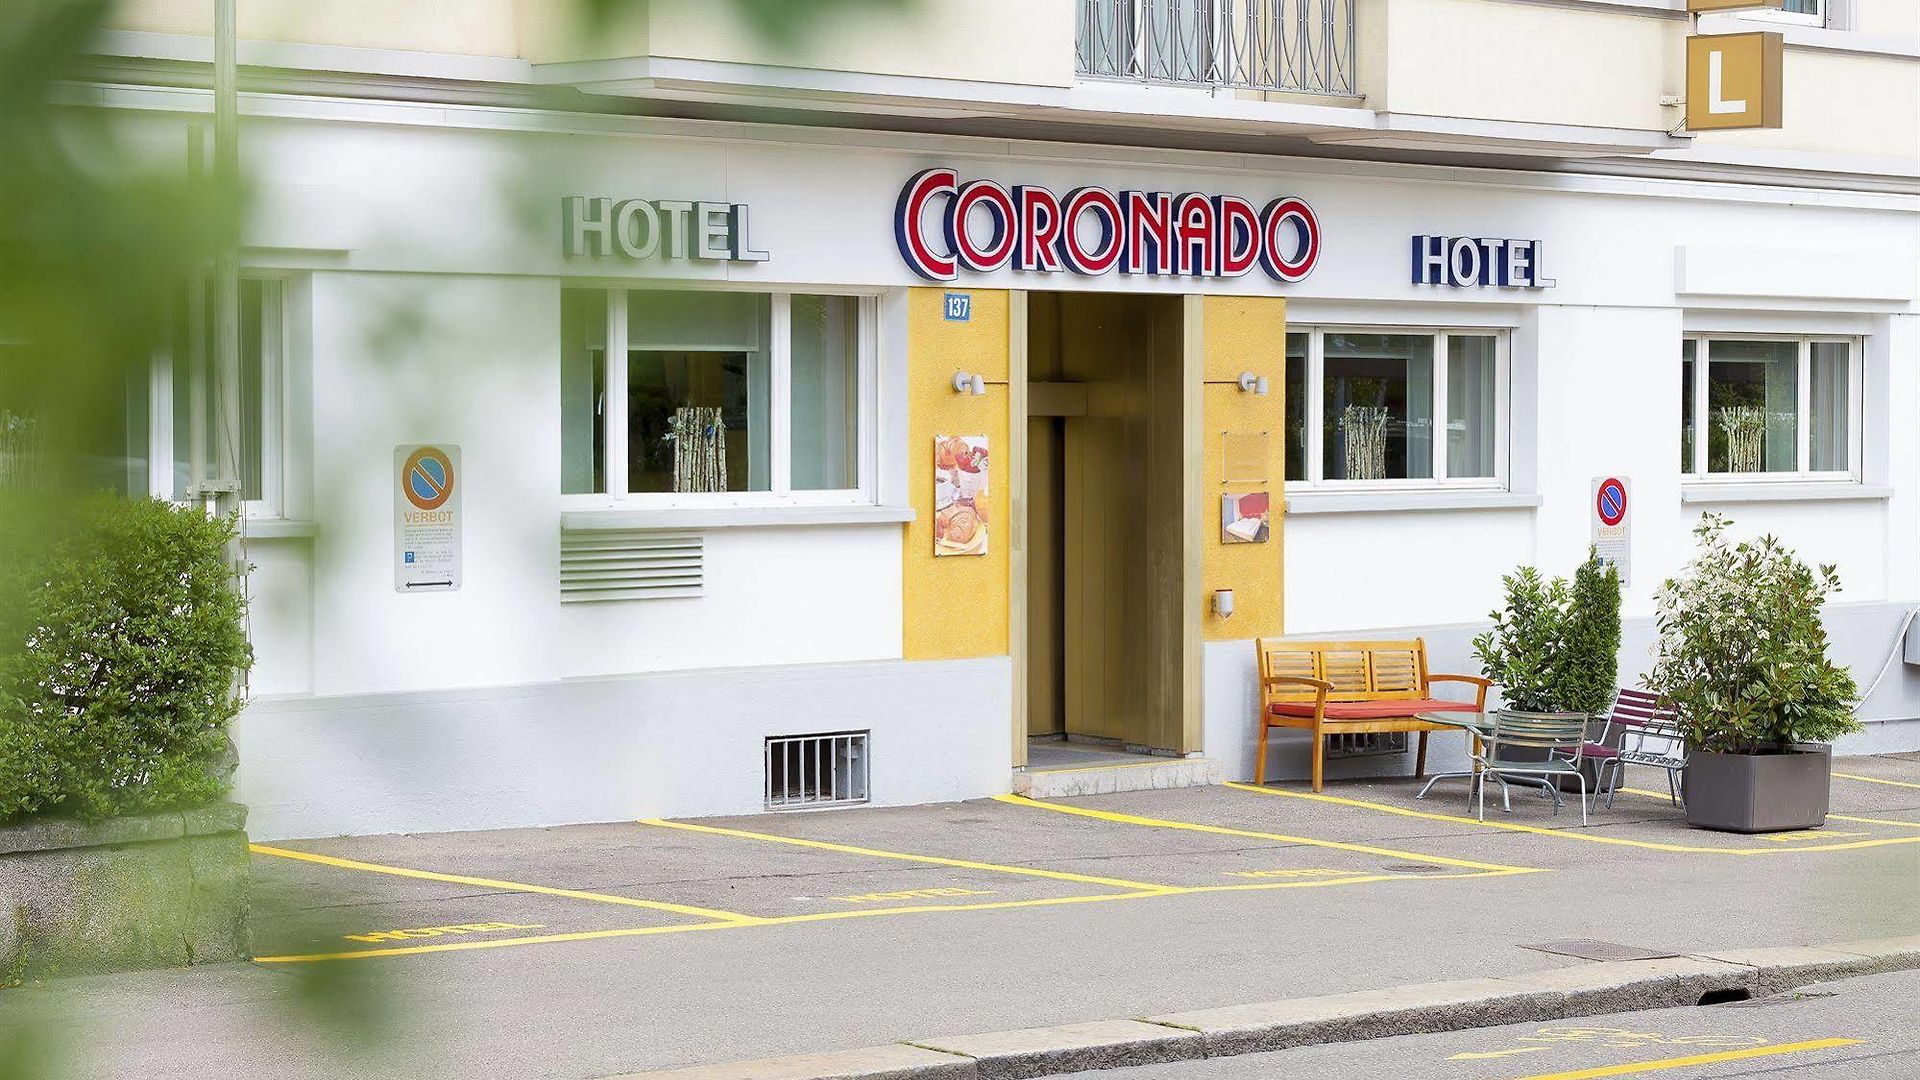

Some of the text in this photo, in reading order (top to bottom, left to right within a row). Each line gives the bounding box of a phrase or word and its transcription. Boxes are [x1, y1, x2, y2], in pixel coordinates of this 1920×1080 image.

[1709, 50, 1746, 114] L
[563, 196, 770, 261] HOTEL
[894, 167, 1322, 284] CORONADO
[1411, 234, 1557, 289] HOTEL
[947, 297, 969, 317] 137
[404, 511, 453, 523] VERBOT
[343, 921, 547, 943] HOTEL
